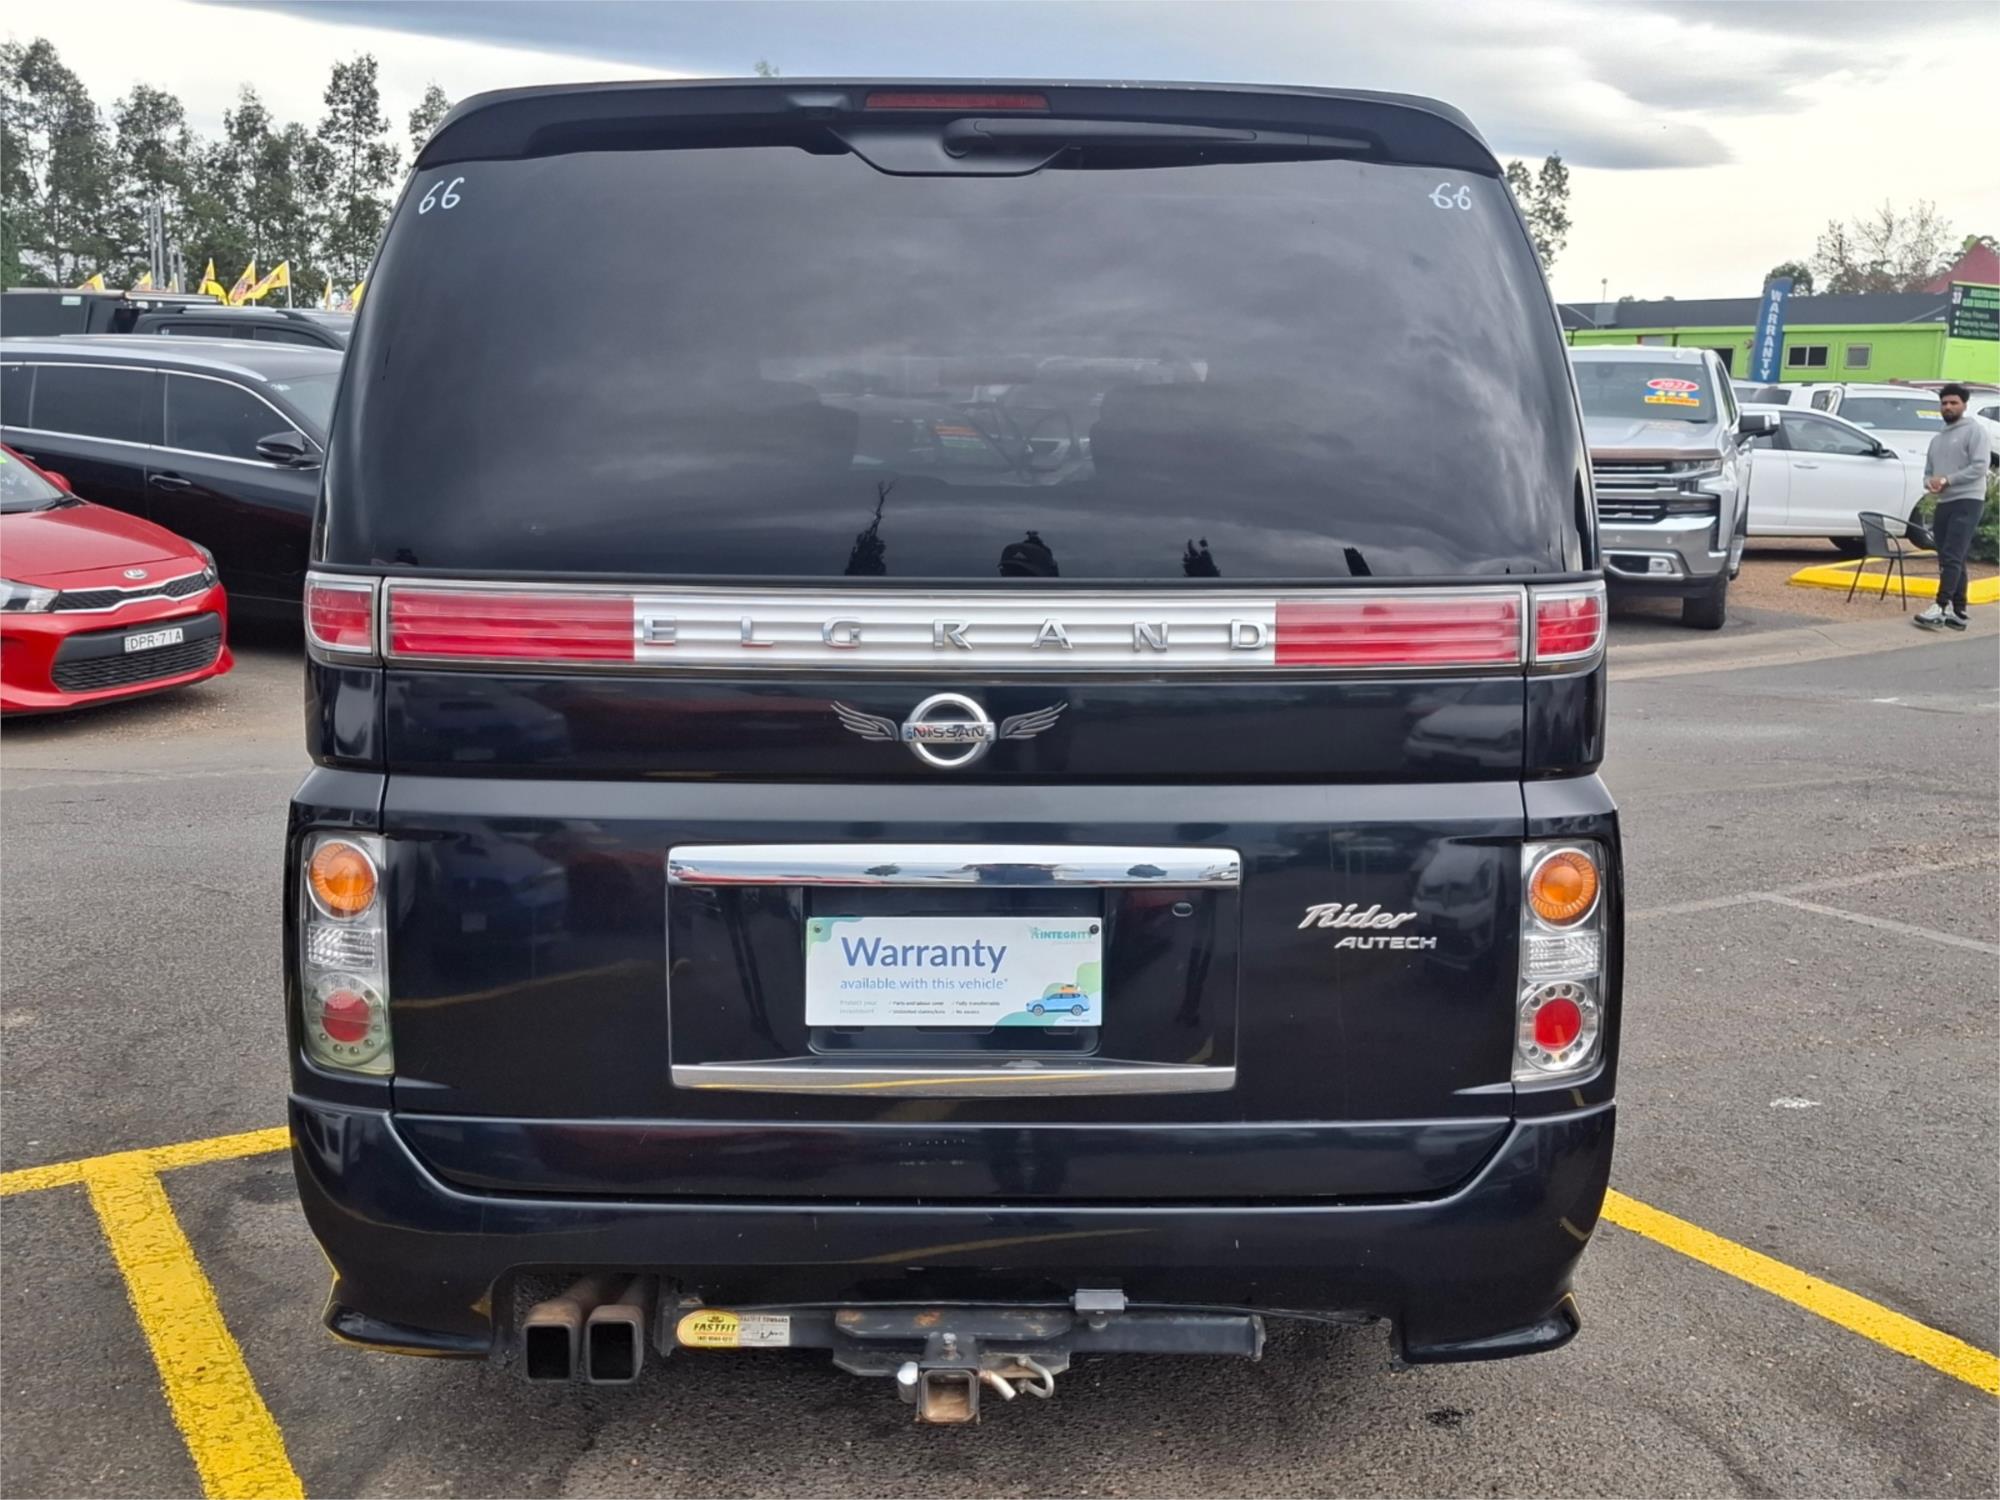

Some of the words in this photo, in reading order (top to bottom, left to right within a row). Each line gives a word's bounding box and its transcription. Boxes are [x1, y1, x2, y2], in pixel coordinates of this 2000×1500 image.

[418, 176, 465, 215] 66
[1428, 182, 1472, 211] 66
[1760, 289, 1782, 380] WARRANTY
[643, 614, 1269, 652] ELGRAND
[912, 725, 985, 739] NISSAN
[1298, 903, 1418, 929] Rider
[841, 937, 1007, 973] Warranty
[1334, 936, 1438, 950] AUTECH
[840, 977, 896, 990] available
[899, 977, 929, 990] with
[932, 977, 955, 990] this
[693, 1322, 738, 1332] FASTFIT
